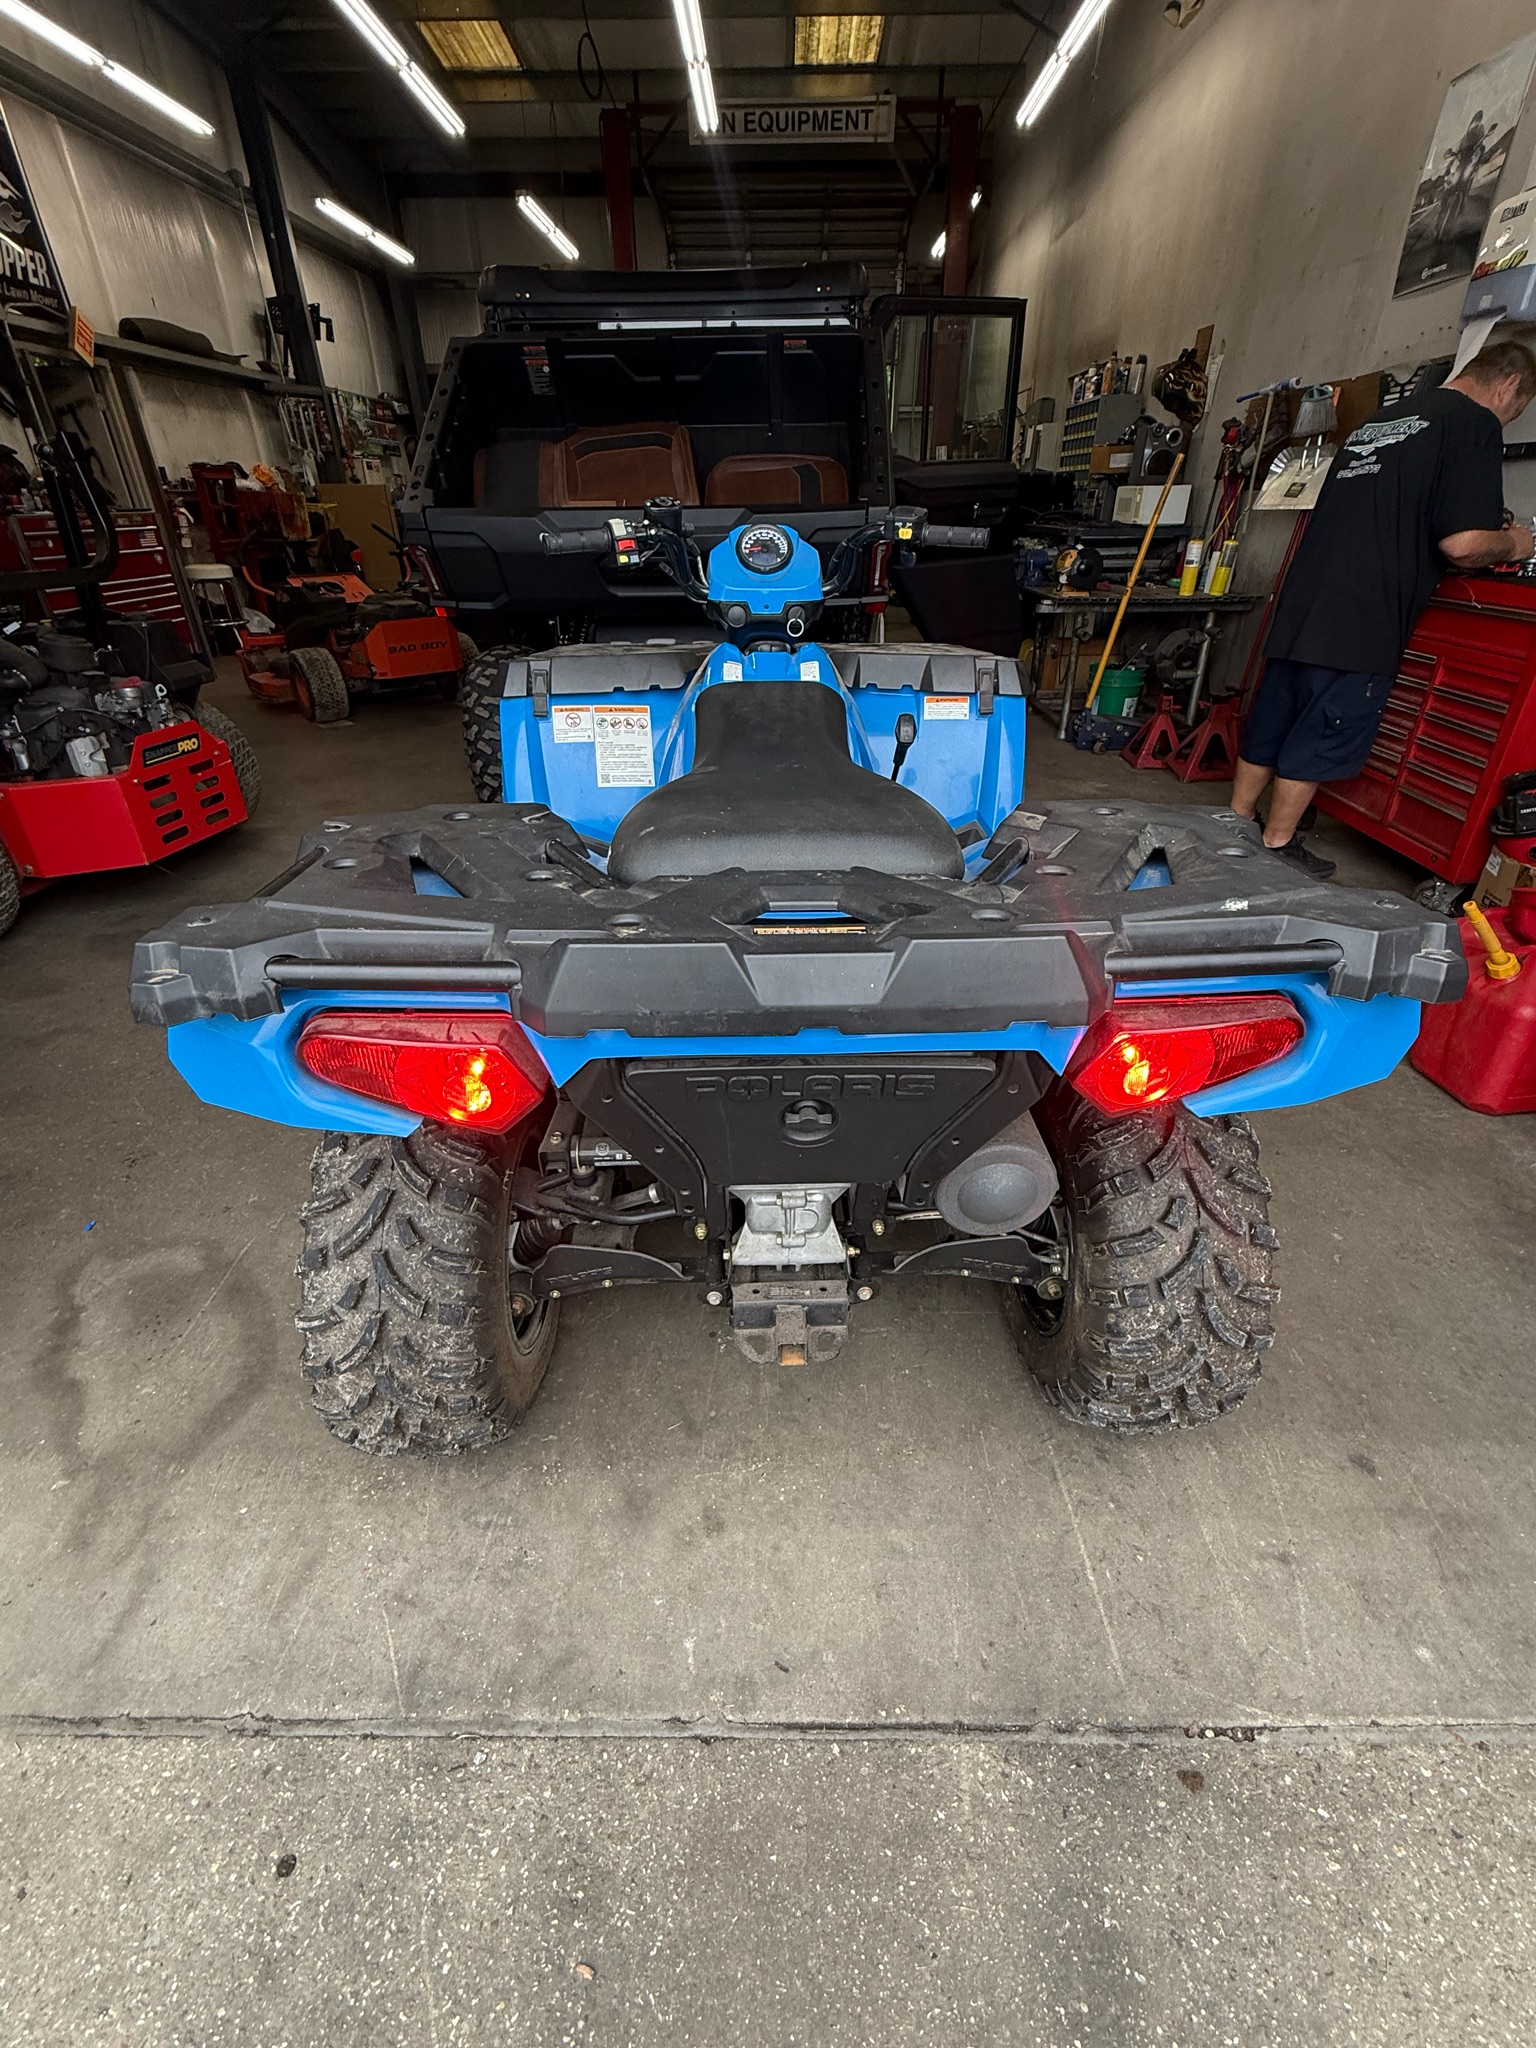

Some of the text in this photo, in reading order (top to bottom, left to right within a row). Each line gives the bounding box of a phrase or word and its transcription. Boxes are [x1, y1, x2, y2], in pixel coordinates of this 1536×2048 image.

[743, 108, 875, 133] EQUIPMENT
[388, 640, 448, 654] BAD BOY
[178, 738, 198, 753] PRO
[686, 1074, 936, 1100] POLARIS
